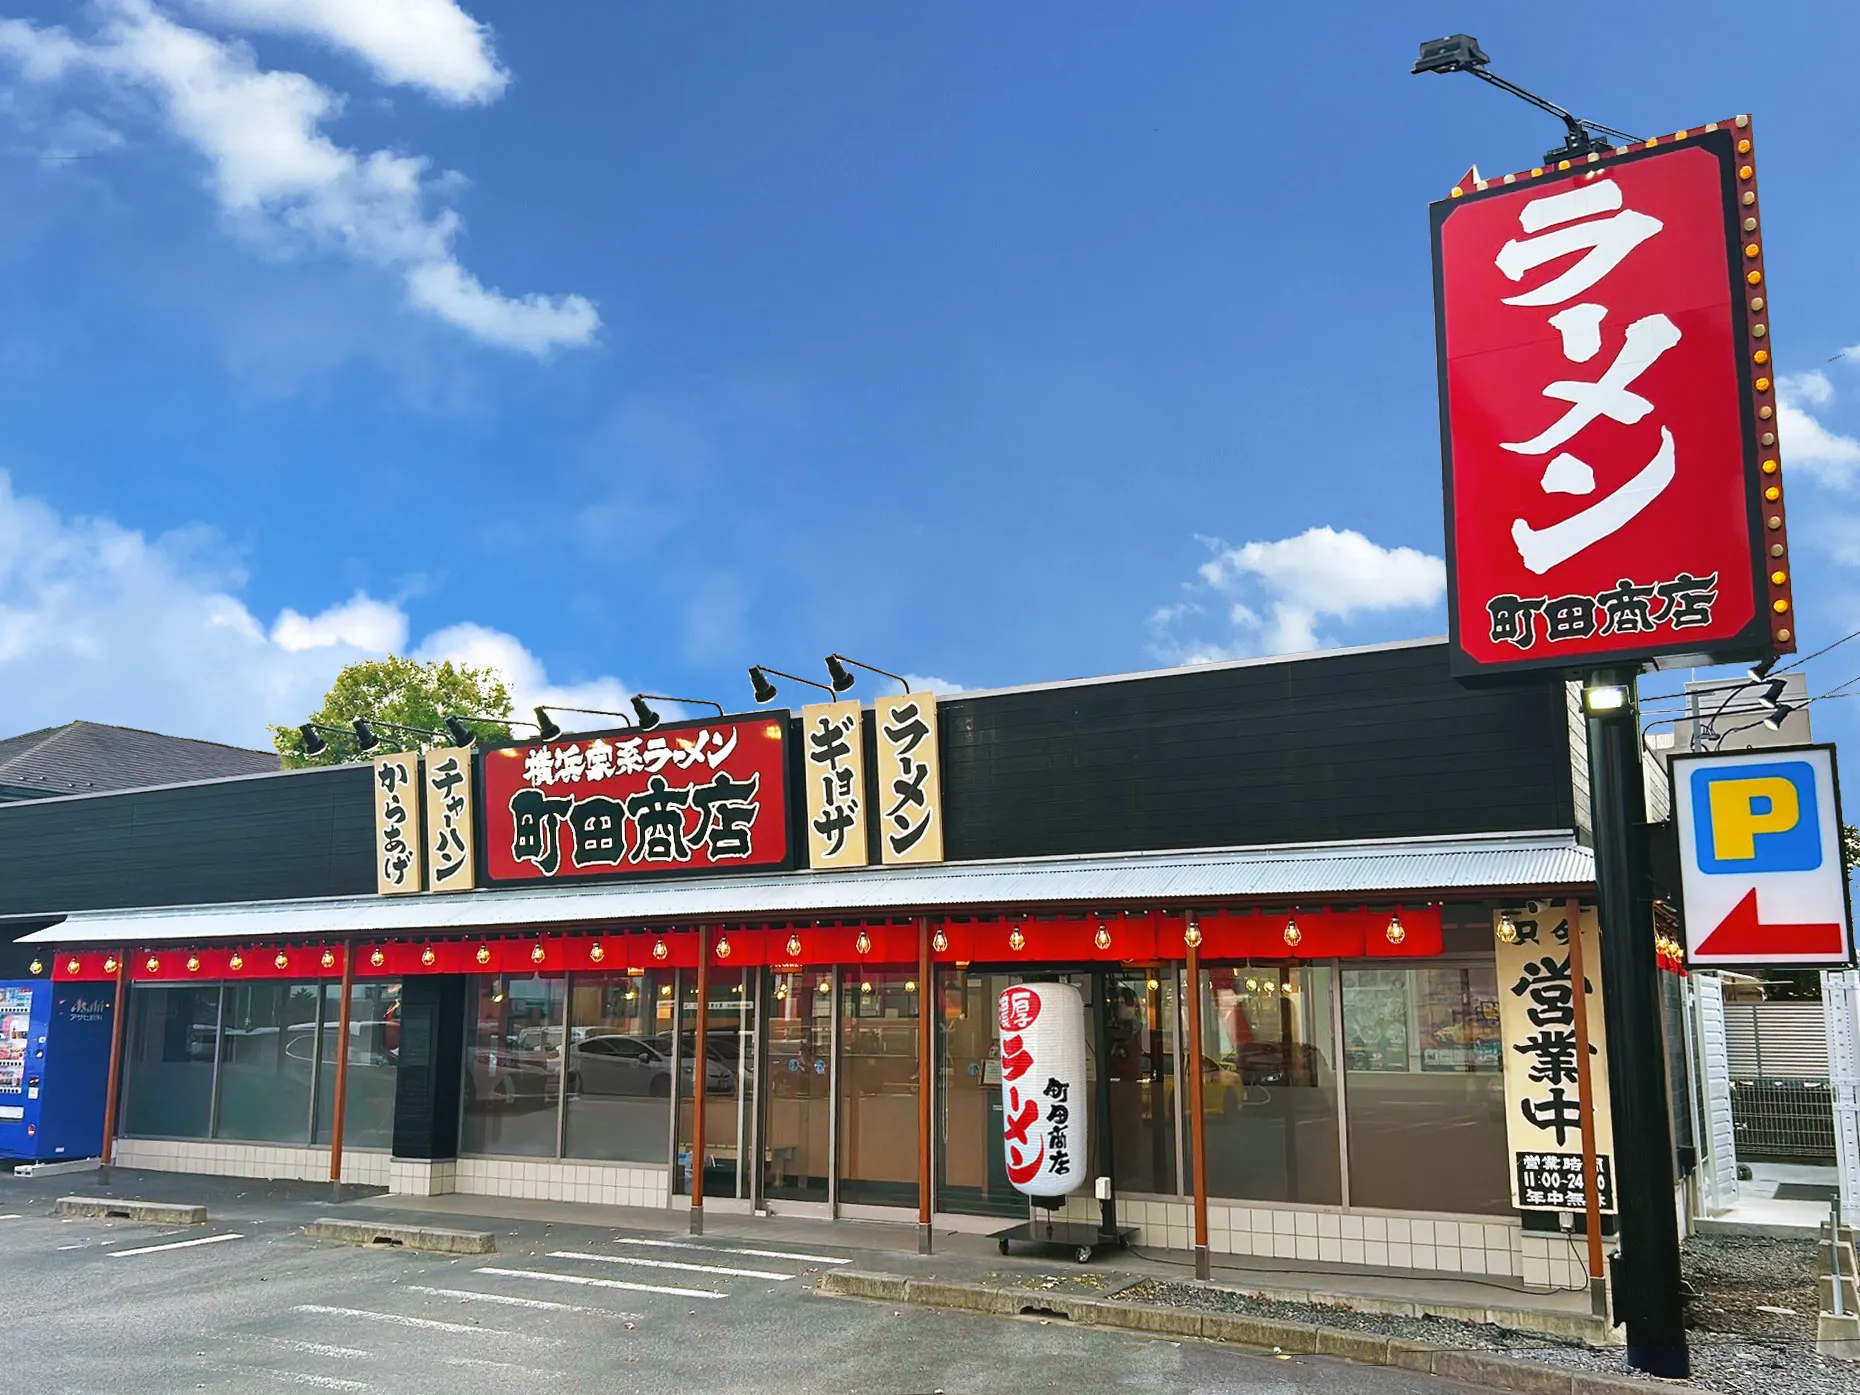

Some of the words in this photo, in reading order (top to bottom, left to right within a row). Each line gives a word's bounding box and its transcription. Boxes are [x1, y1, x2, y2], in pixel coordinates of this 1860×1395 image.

[1495, 179, 1682, 575] ラーメン
[1487, 573, 1719, 649] 町田商店
[523, 727, 738, 786] 横浜家系ラーメン
[809, 714, 860, 858] ギョーザ
[881, 702, 932, 857] ラーメン
[1708, 776, 1800, 861] P
[377, 761, 414, 886] からあげ
[430, 757, 467, 883] チャーハン
[509, 771, 760, 876] 町田商店
[1001, 1034, 1045, 1185] ラーメン
[1511, 952, 1596, 1148] 営業中
[1043, 1077, 1071, 1176] 町田商店
